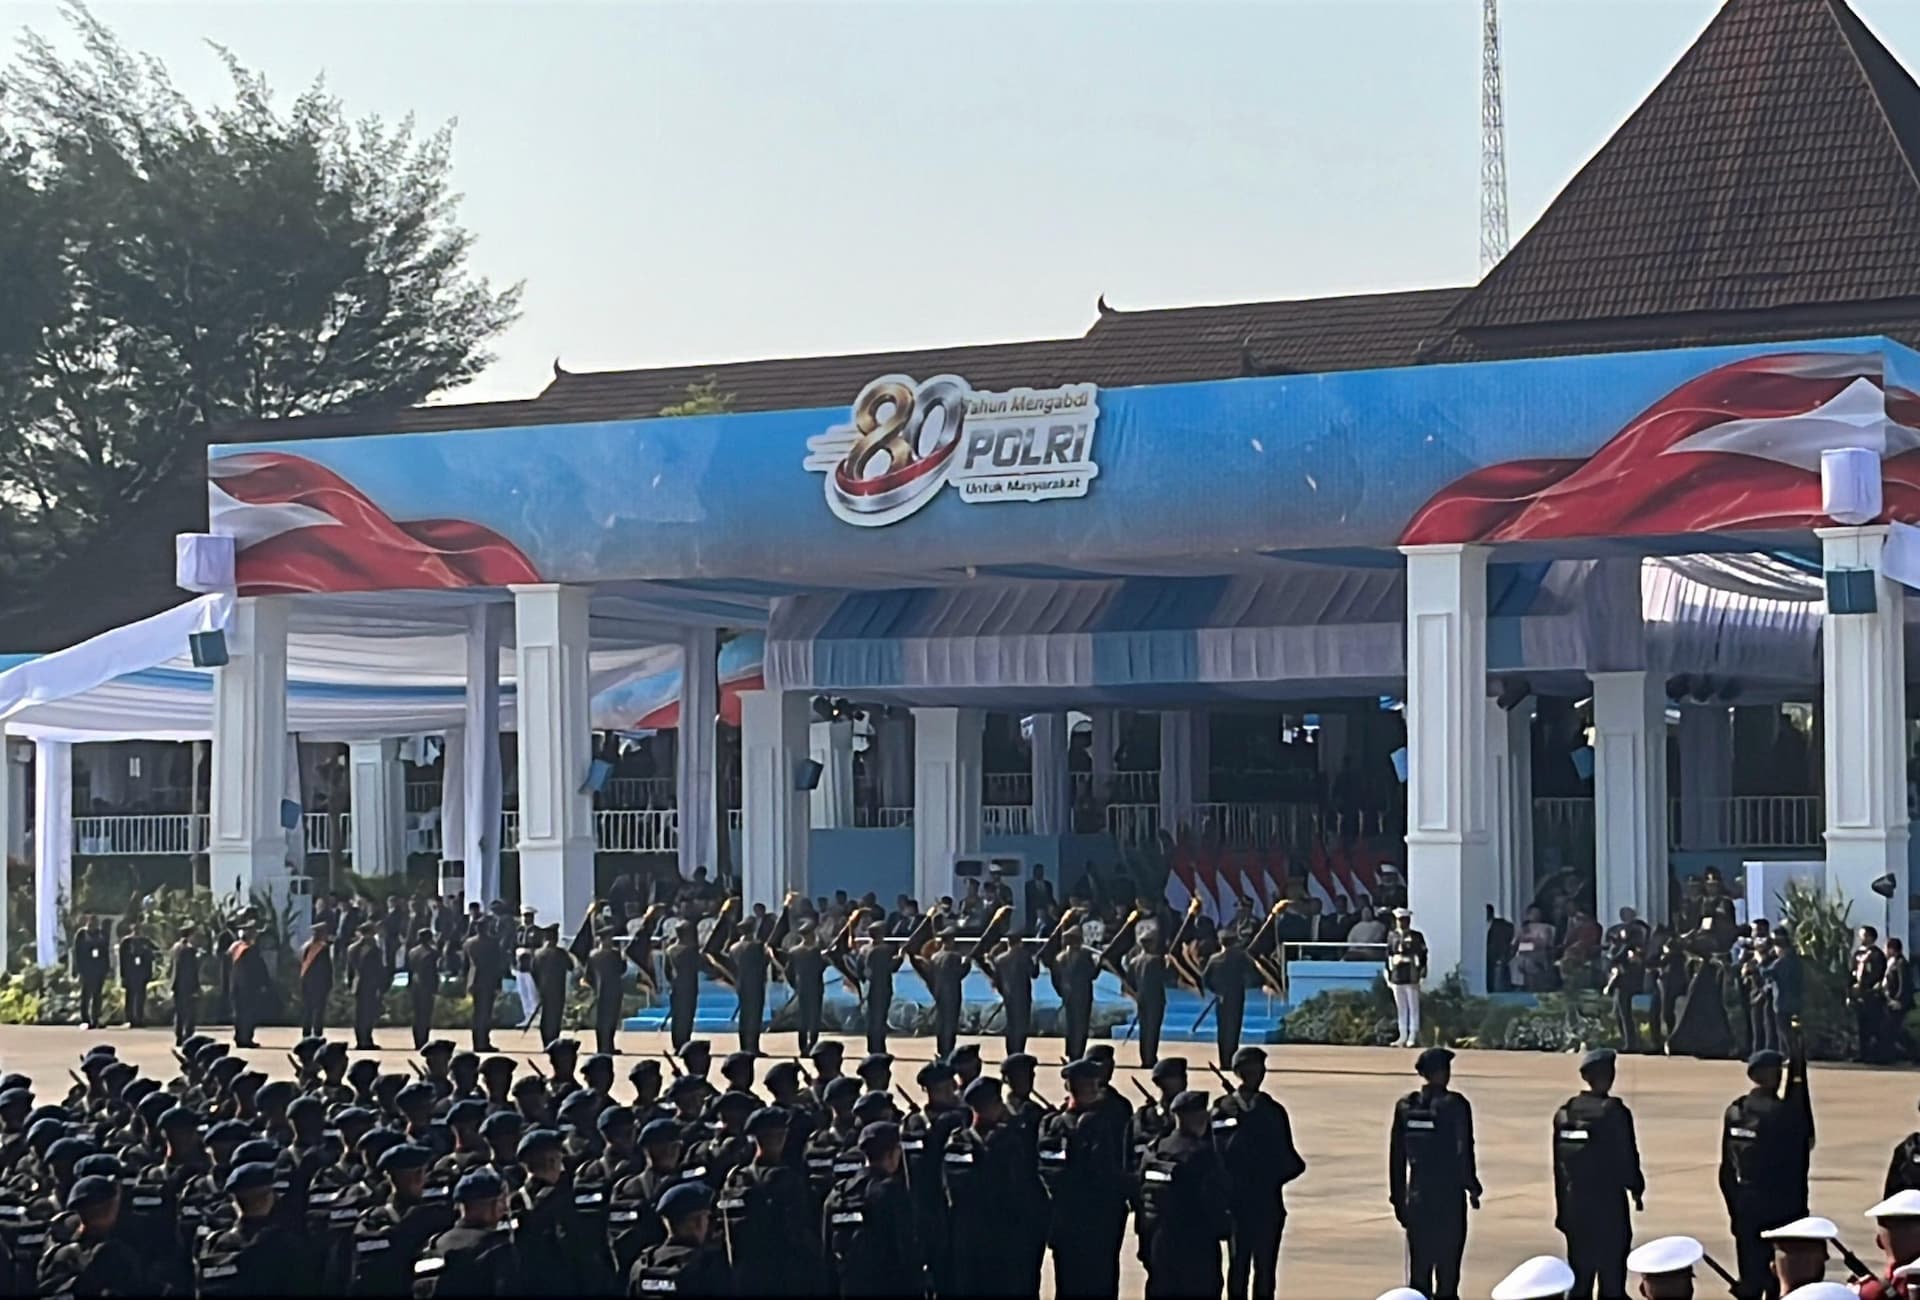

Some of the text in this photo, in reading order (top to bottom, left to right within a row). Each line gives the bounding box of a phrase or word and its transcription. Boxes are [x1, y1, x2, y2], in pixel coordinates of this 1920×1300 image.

[1010, 391, 1089, 414] Mengabdi
[846, 380, 966, 486] 80
[964, 423, 1089, 470] POLRI
[966, 477, 1081, 494] Untuk Masyarakat
